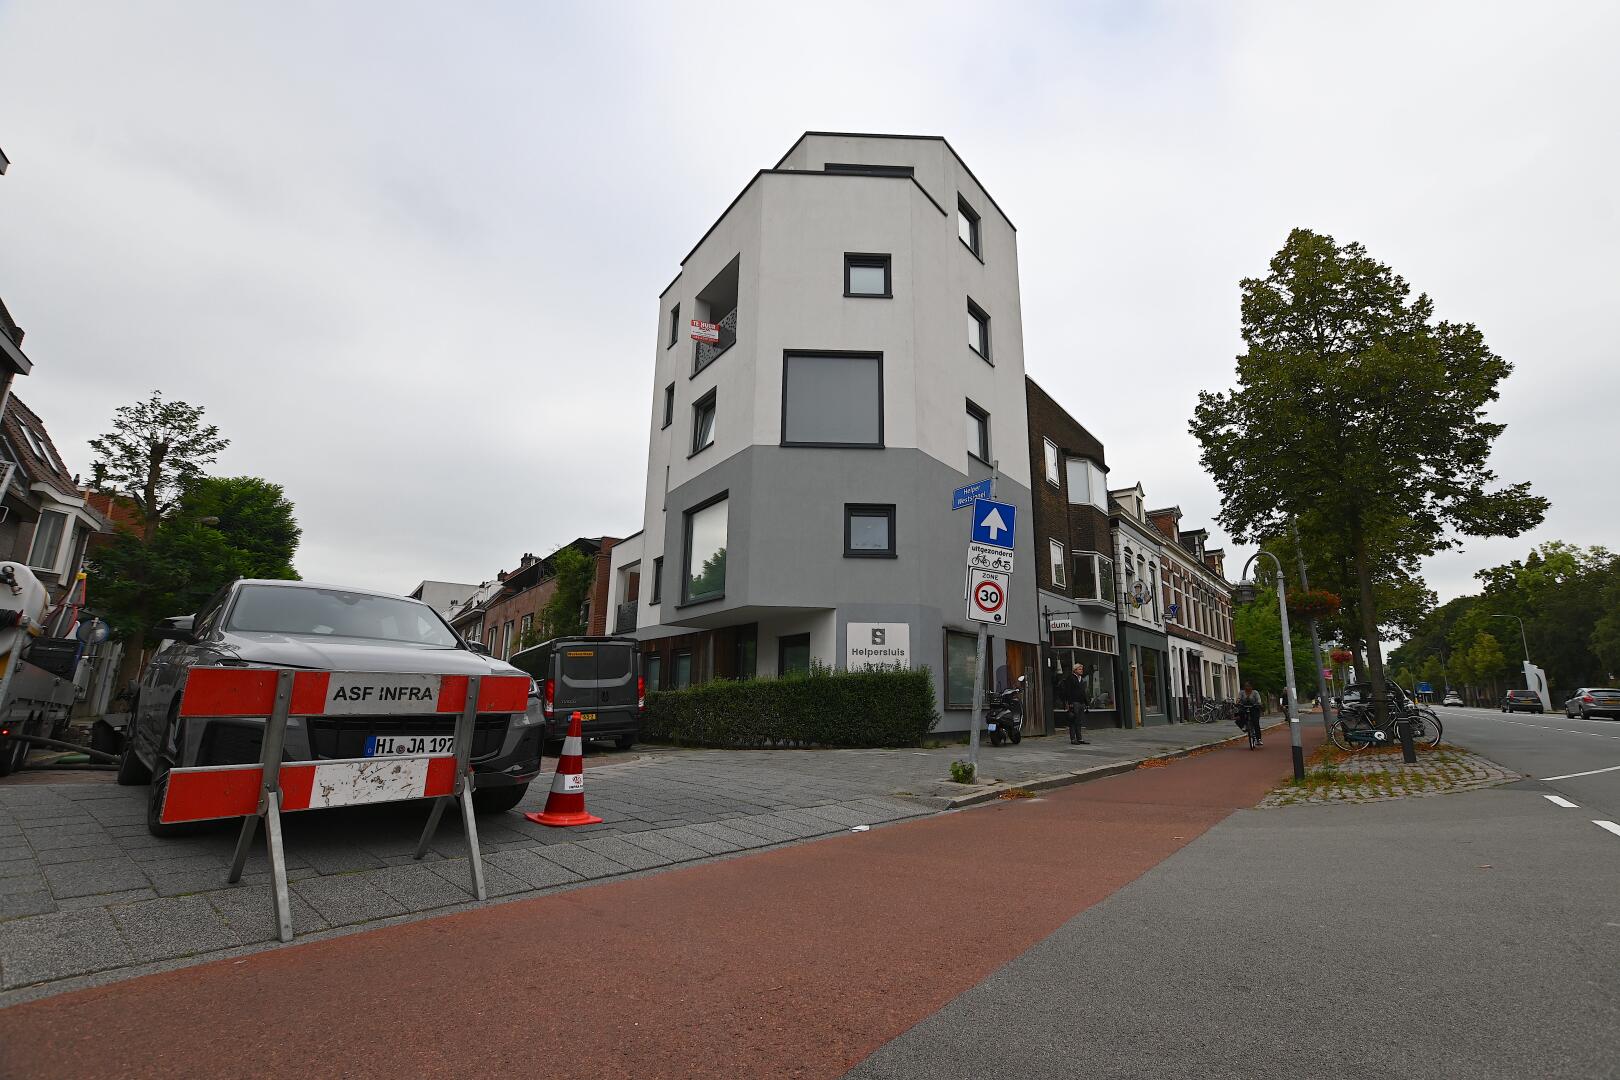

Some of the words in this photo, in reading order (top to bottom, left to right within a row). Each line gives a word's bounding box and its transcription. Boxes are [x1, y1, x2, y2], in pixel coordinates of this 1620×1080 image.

[963, 485, 981, 494] Helper
[971, 545, 1013, 557] uitgezonderd
[982, 572, 999, 581] ZONE
[980, 589, 998, 604] 30
[1051, 620, 1070, 629] dunk
[851, 648, 905, 657] Helpersluis
[333, 686, 374, 701] ASF
[378, 686, 433, 701] INFRA
[375, 738, 395, 754] HI
[406, 738, 425, 753] JA
[429, 737, 454, 753] 197
